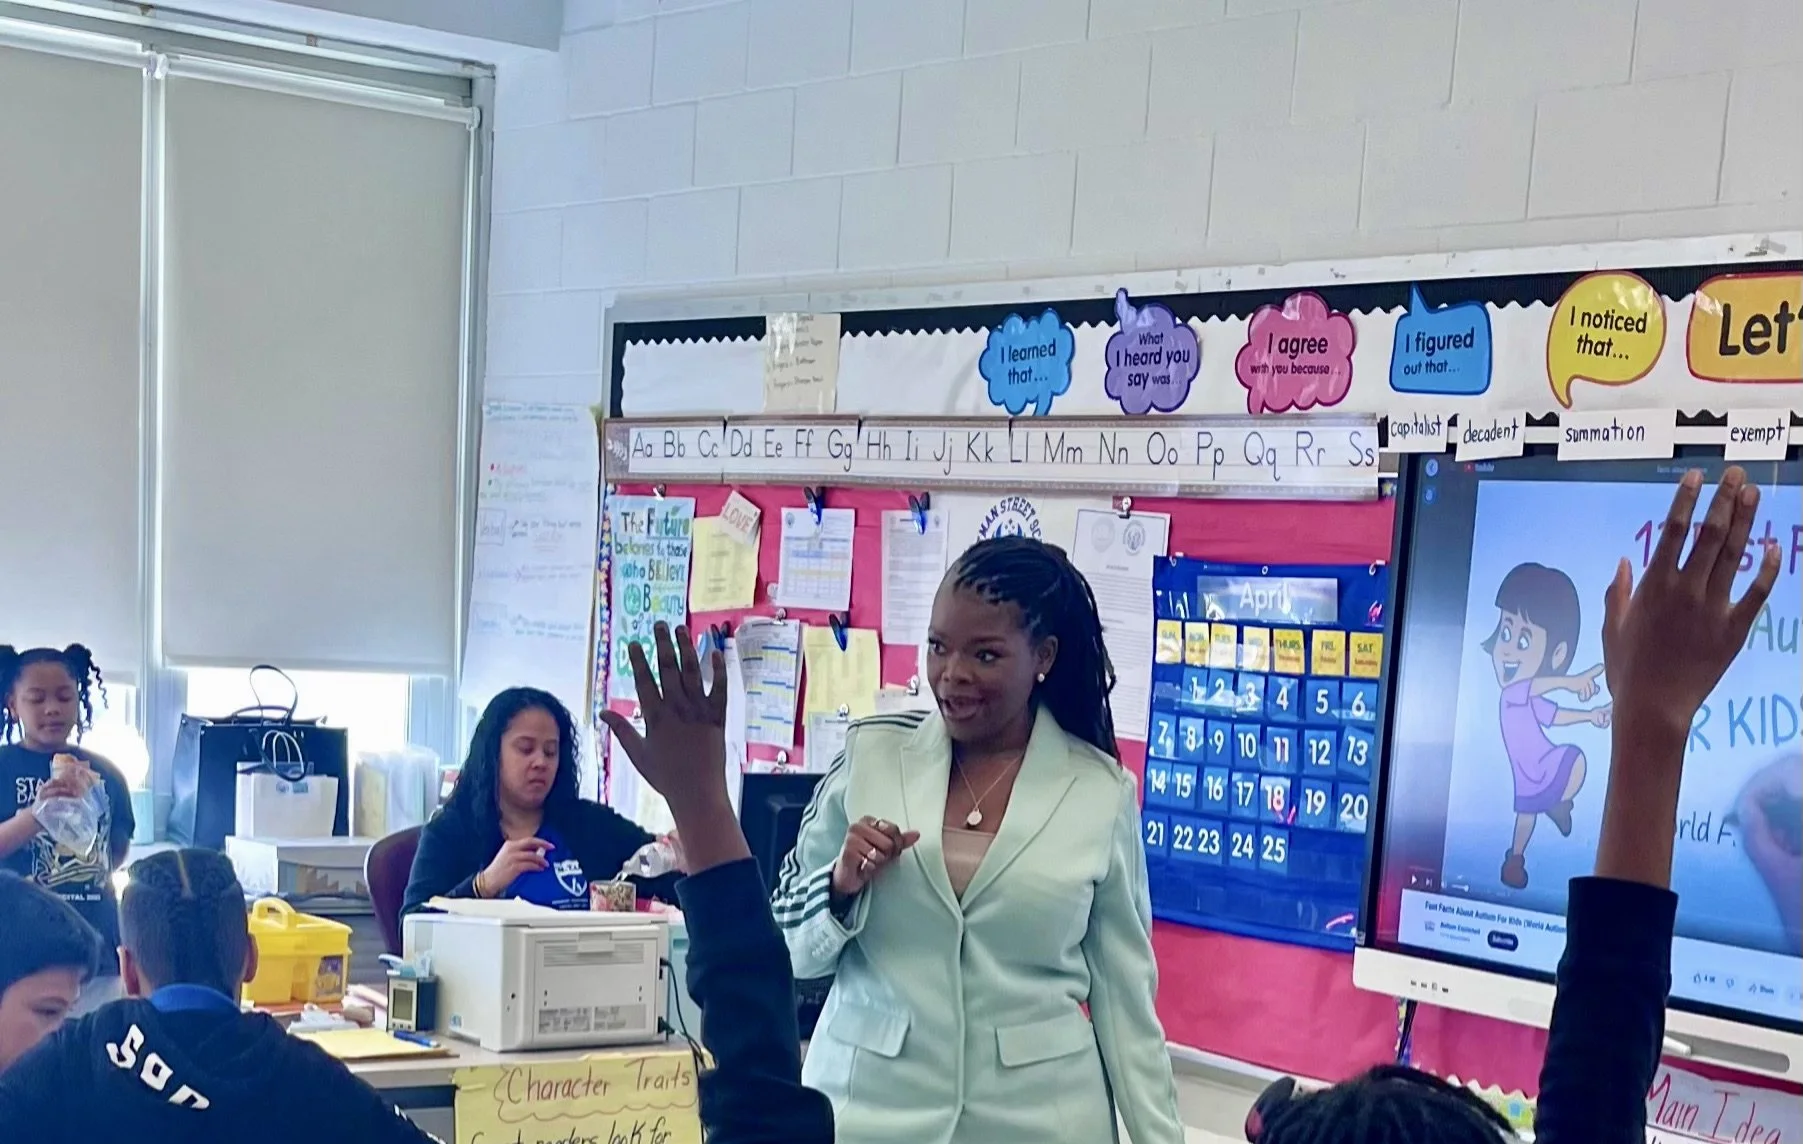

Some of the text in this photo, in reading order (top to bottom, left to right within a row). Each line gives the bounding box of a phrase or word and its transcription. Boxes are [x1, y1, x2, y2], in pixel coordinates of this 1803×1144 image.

[1570, 305, 1648, 334] I noticed
[1008, 338, 1056, 364] learned
[1138, 332, 1163, 345] What
[1268, 333, 1329, 360] I agree
[1415, 327, 1475, 357] figured
[1577, 333, 1630, 360] that...
[1124, 349, 1162, 367] heard
[1165, 349, 1190, 370] you
[1250, 362, 1270, 375] with
[1272, 365, 1288, 376] you
[1403, 362, 1422, 376] out
[1127, 372, 1149, 390] say
[1390, 412, 1442, 440] capitalist
[1463, 417, 1519, 444] decadent
[1565, 416, 1645, 443] summation
[1731, 418, 1786, 446] exempt
[632, 428, 1375, 482] Aa Bb Cc Dd Ee Ff Gg Hh Ii Jj Kk Ll Mm Nn Oo Pp Qq Rr Ss
[621, 511, 644, 533] The
[722, 502, 752, 533] LOVE
[1000, 496, 1036, 521] STREET
[621, 560, 646, 579] who
[1239, 582, 1291, 617] April
[1747, 602, 1803, 654] Au
[1276, 686, 1289, 711] 4
[1316, 689, 1329, 714] 5
[1351, 691, 1366, 717] 6
[1728, 693, 1803, 749] KID
[1158, 721, 1369, 766] 7 8 9 10 11 12 13
[1150, 768, 1369, 821] 14 15 16 17 18 19 20
[1146, 820, 1286, 863] 21 22 23 24 25
[1455, 905, 1474, 918] About
[1474, 909, 1496, 922] Autism
[1497, 914, 1507, 924] For
[1508, 916, 1523, 927] Kids
[506, 1055, 691, 1105] Character Traits
